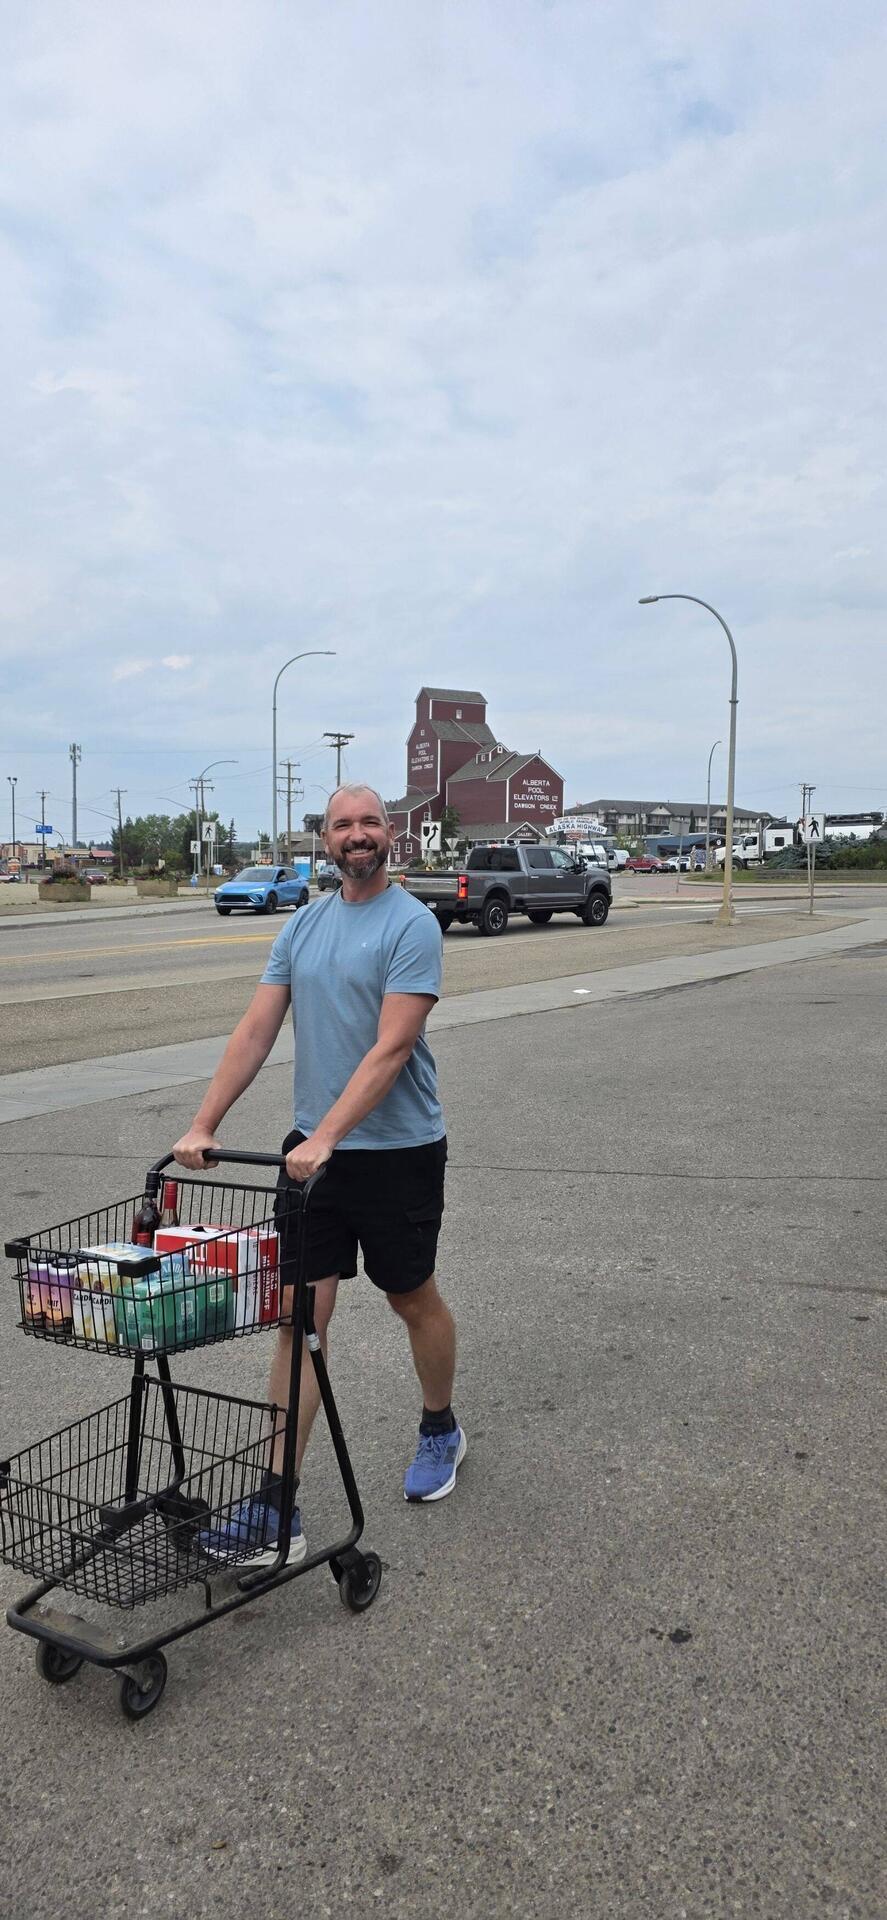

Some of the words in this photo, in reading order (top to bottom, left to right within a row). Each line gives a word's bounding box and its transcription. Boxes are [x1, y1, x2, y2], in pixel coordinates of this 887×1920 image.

[527, 786, 544, 794] POOL
[513, 793, 550, 801] ELEVATORS
[549, 823, 575, 832] ALASKA
[576, 823, 604, 833] HIGHWAY
